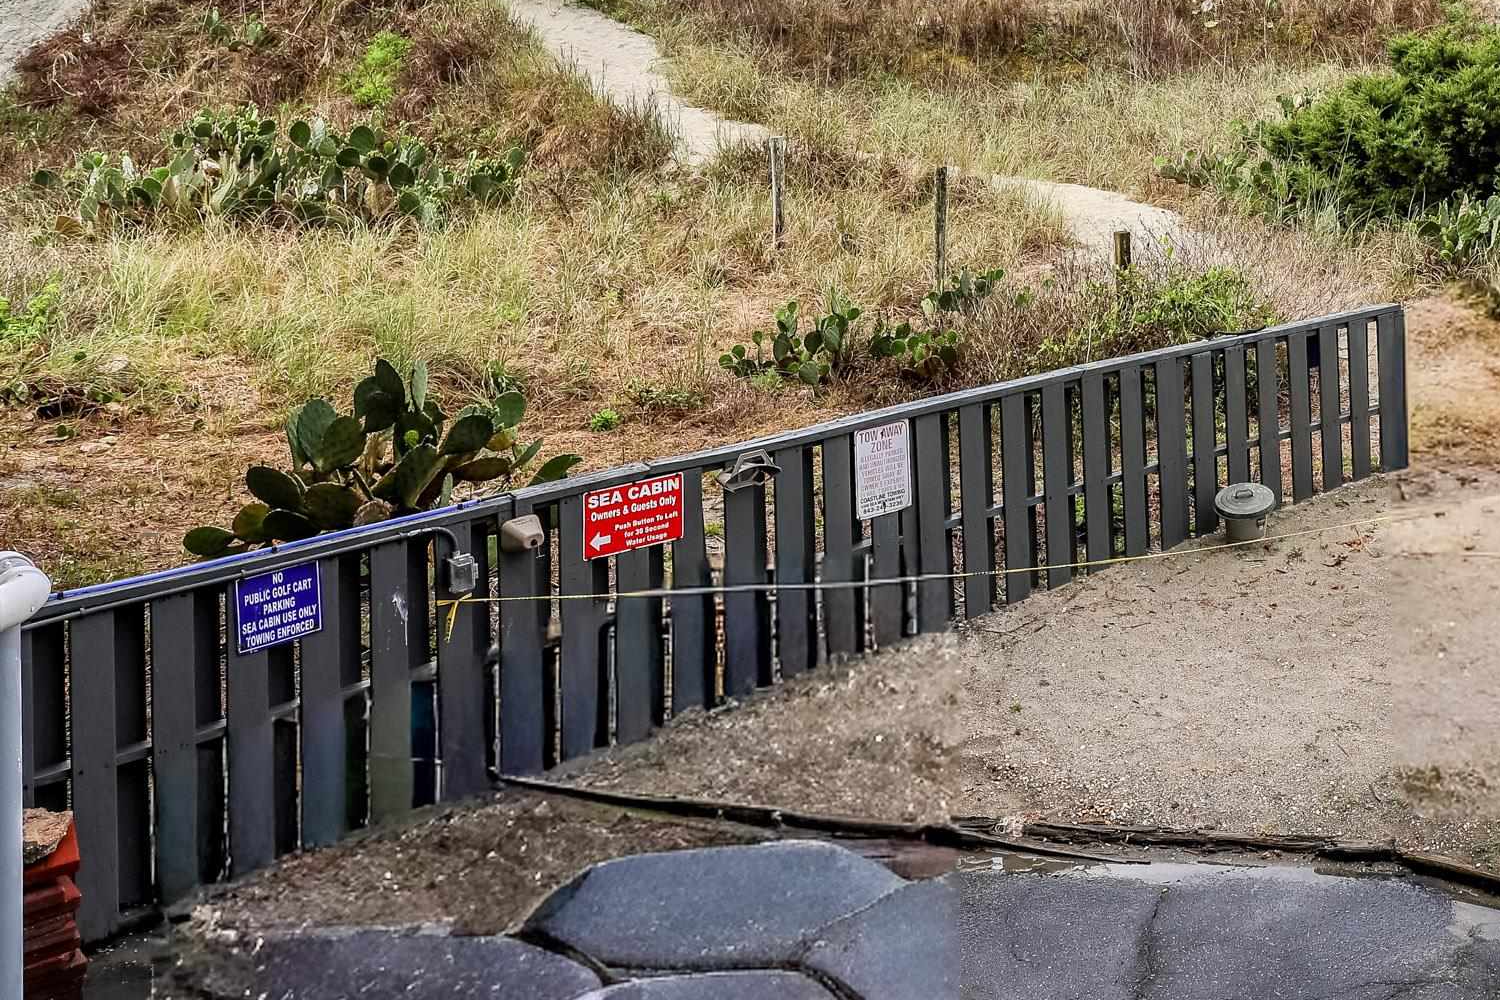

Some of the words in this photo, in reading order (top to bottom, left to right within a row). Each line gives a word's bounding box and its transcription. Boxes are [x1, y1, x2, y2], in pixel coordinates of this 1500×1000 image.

[859, 429, 878, 444] TOW
[880, 424, 903, 439] AWAY
[871, 438, 893, 453] ZONE
[588, 490, 623, 509] SEA
[628, 478, 680, 500] CABIN
[861, 494, 885, 504] COASTLINE
[591, 508, 621, 522] Owners
[623, 505, 629, 514] &
[631, 500, 657, 512] Guests
[660, 495, 676, 506] Only
[615, 521, 631, 531] Push
[633, 516, 655, 526] Button
[665, 511, 678, 519] Left
[645, 523, 669, 533] Second
[626, 537, 646, 546] Water
[647, 532, 668, 541] Usage
[272, 572, 284, 584] NO
[244, 590, 271, 606] PUBLIC
[272, 584, 291, 598] GOLF
[293, 578, 312, 592] CART
[263, 597, 296, 615] PARKING
[242, 622, 257, 634] SEA
[258, 616, 281, 630] CABIN
[282, 610, 297, 623] USE
[299, 604, 317, 618] ONLY
[246, 630, 275, 647] TOWING
[277, 619, 314, 639] ENFORCED
